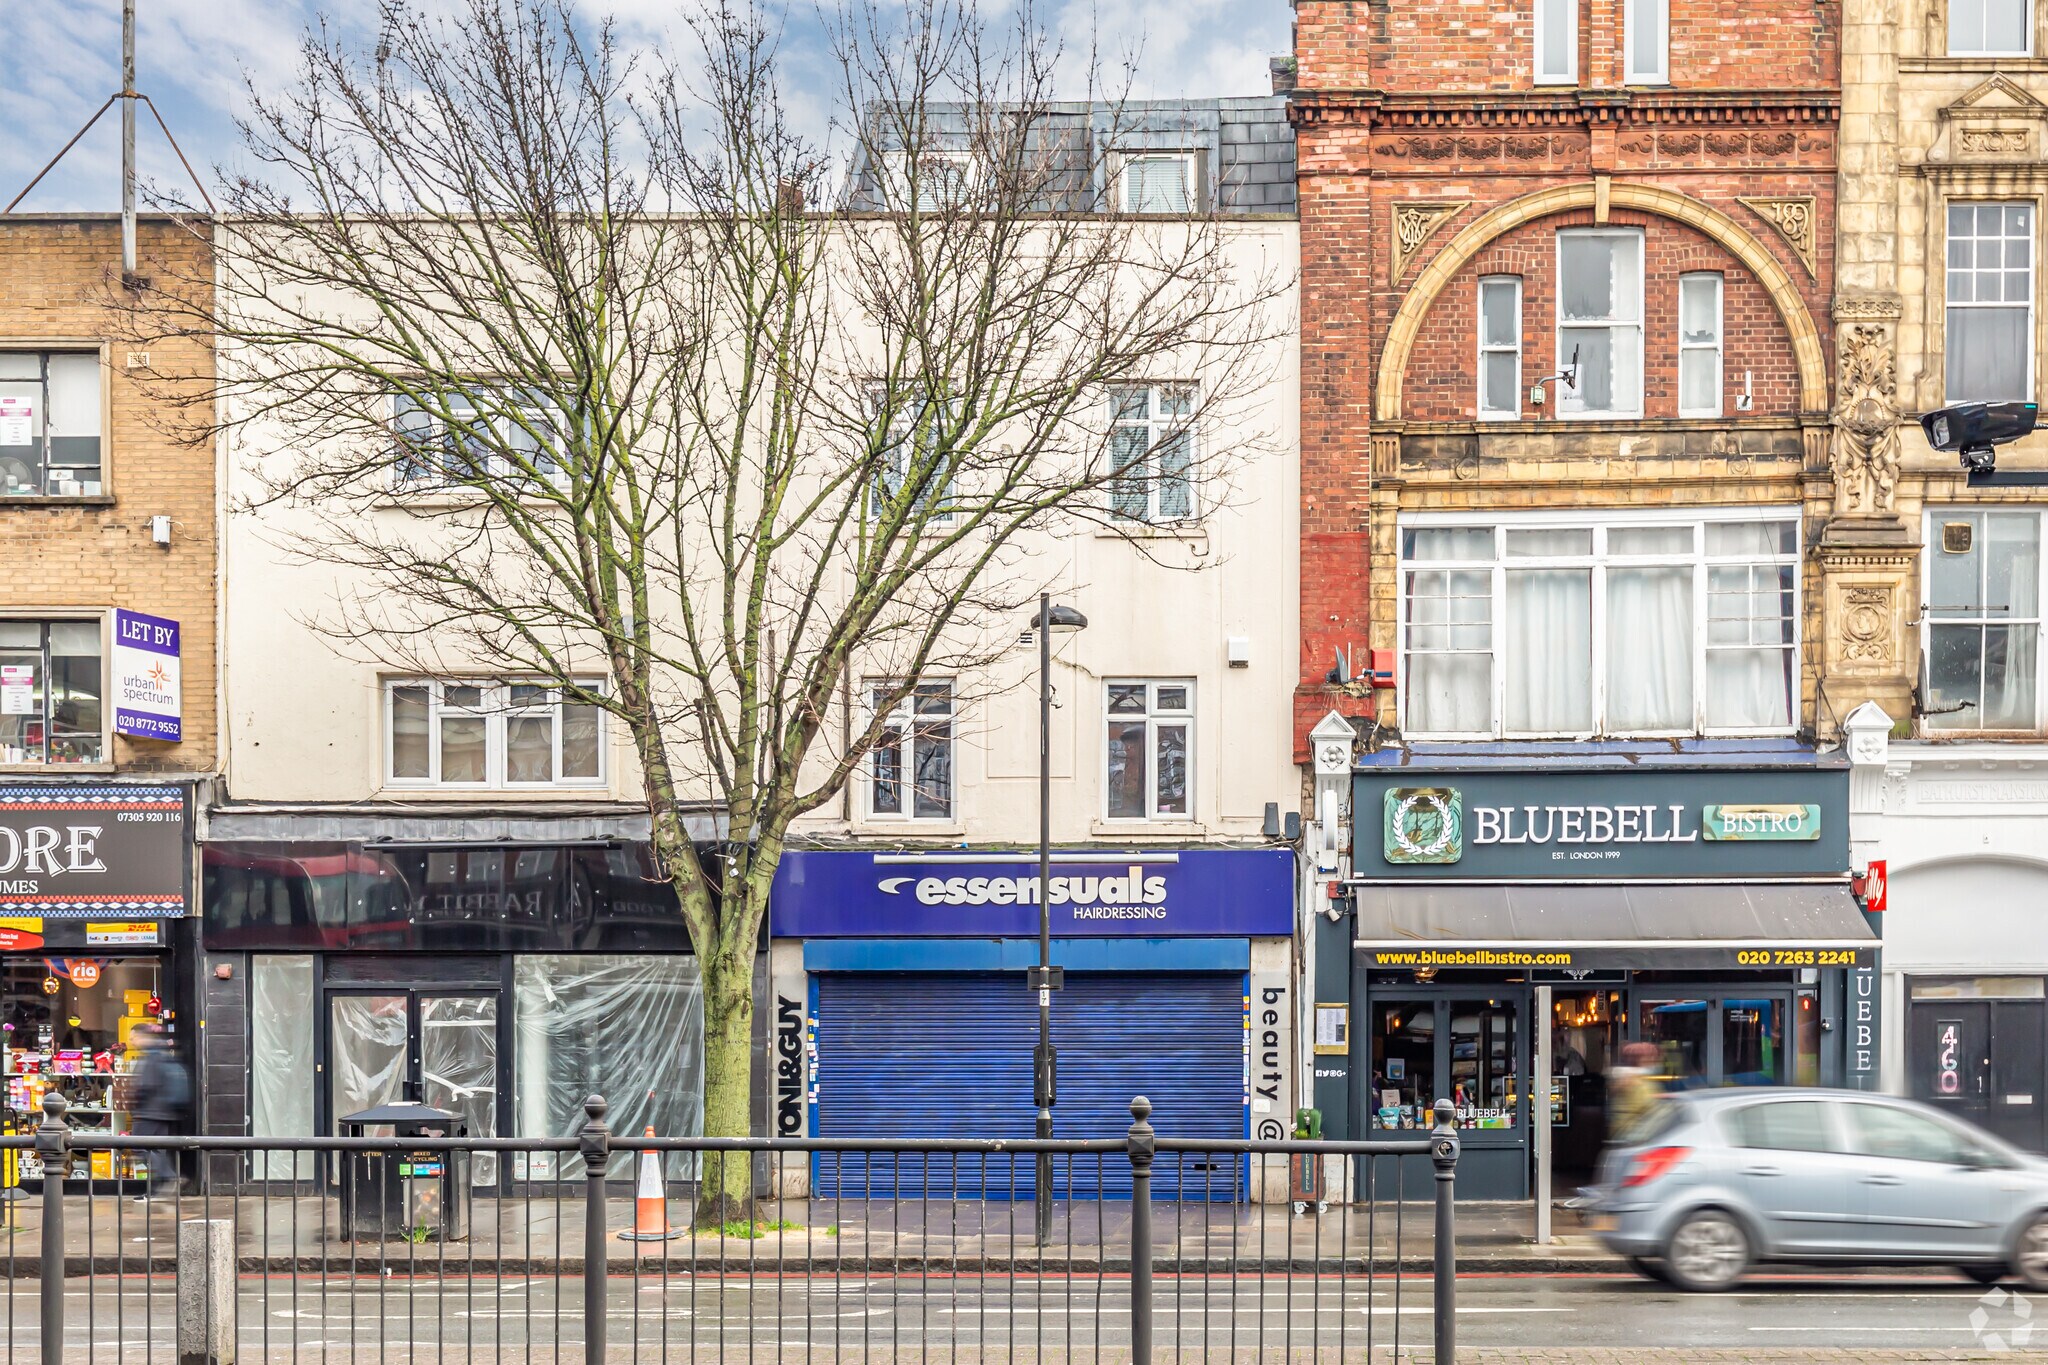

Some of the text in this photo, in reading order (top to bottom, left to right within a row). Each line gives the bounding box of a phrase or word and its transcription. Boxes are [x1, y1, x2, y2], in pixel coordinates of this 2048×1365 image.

[122, 619, 174, 646] LET BY
[123, 675, 155, 690] urban
[123, 688, 174, 705] spectrum
[119, 715, 178, 734] 020 8772 9552
[117, 813, 181, 822] 07305 920 116
[1473, 805, 1698, 844] BLUEBELL
[1723, 812, 1802, 833] BISTRO
[1552, 851, 1621, 860] EST. LONDON 1999
[915, 865, 1168, 905] essensuals
[1073, 907, 1167, 920] HAIRDRESSING
[1376, 950, 1571, 965] www.bluebellbistro.com
[1737, 951, 1856, 965] 020 7263 2241
[73, 961, 97, 977] ria
[1256, 987, 1286, 1101] beauty
[1942, 1025, 1958, 1094] 460
[1457, 1108, 1508, 1118] BLUEBELL
